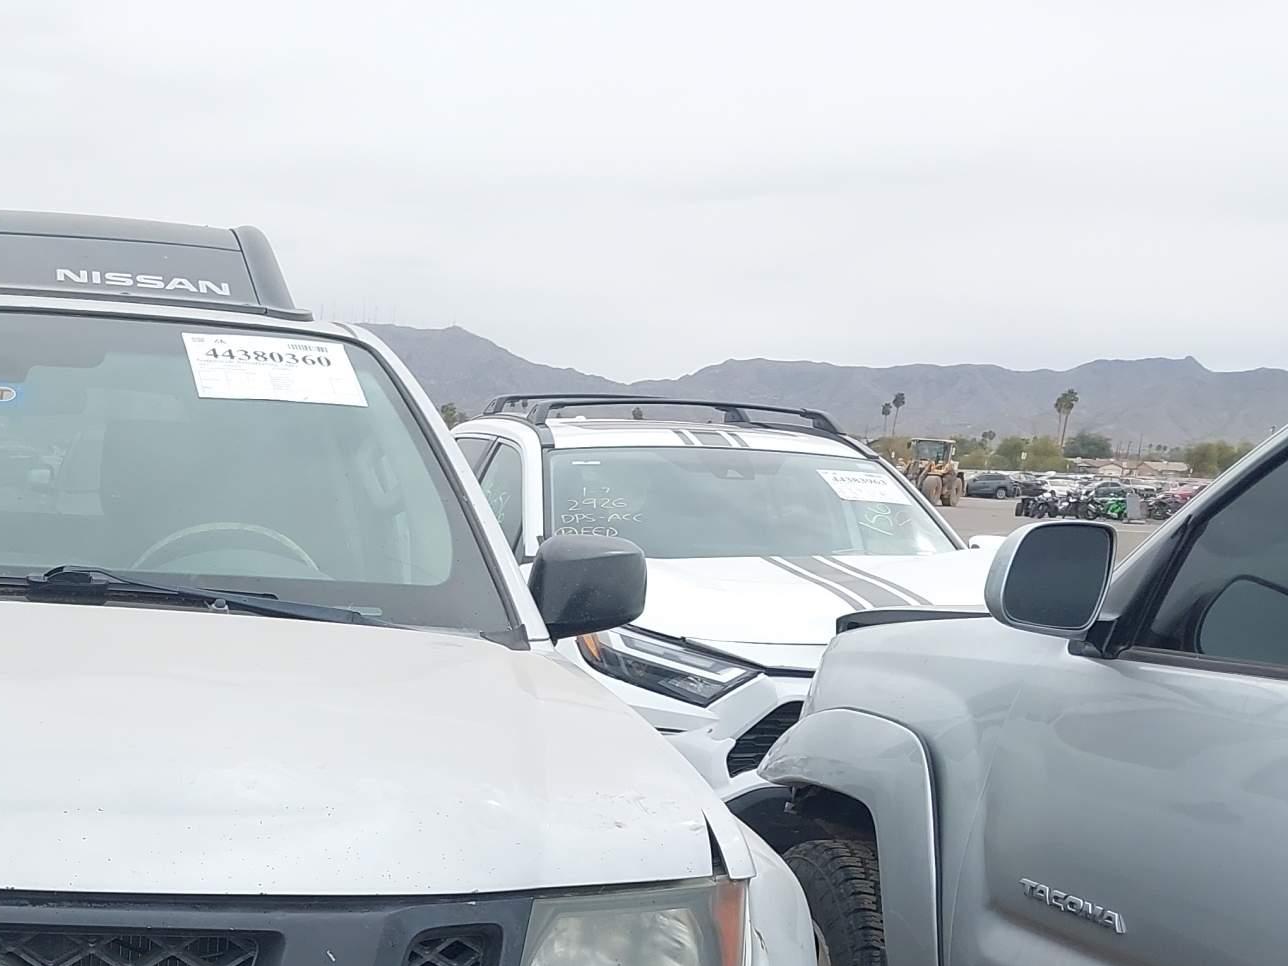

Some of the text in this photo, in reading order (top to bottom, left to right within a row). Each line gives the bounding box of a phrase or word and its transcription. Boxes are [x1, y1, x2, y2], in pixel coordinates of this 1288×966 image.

[56, 269, 230, 295] NISSAN
[205, 347, 332, 367] 44380360
[1019, 878, 1127, 934] TACOMA
